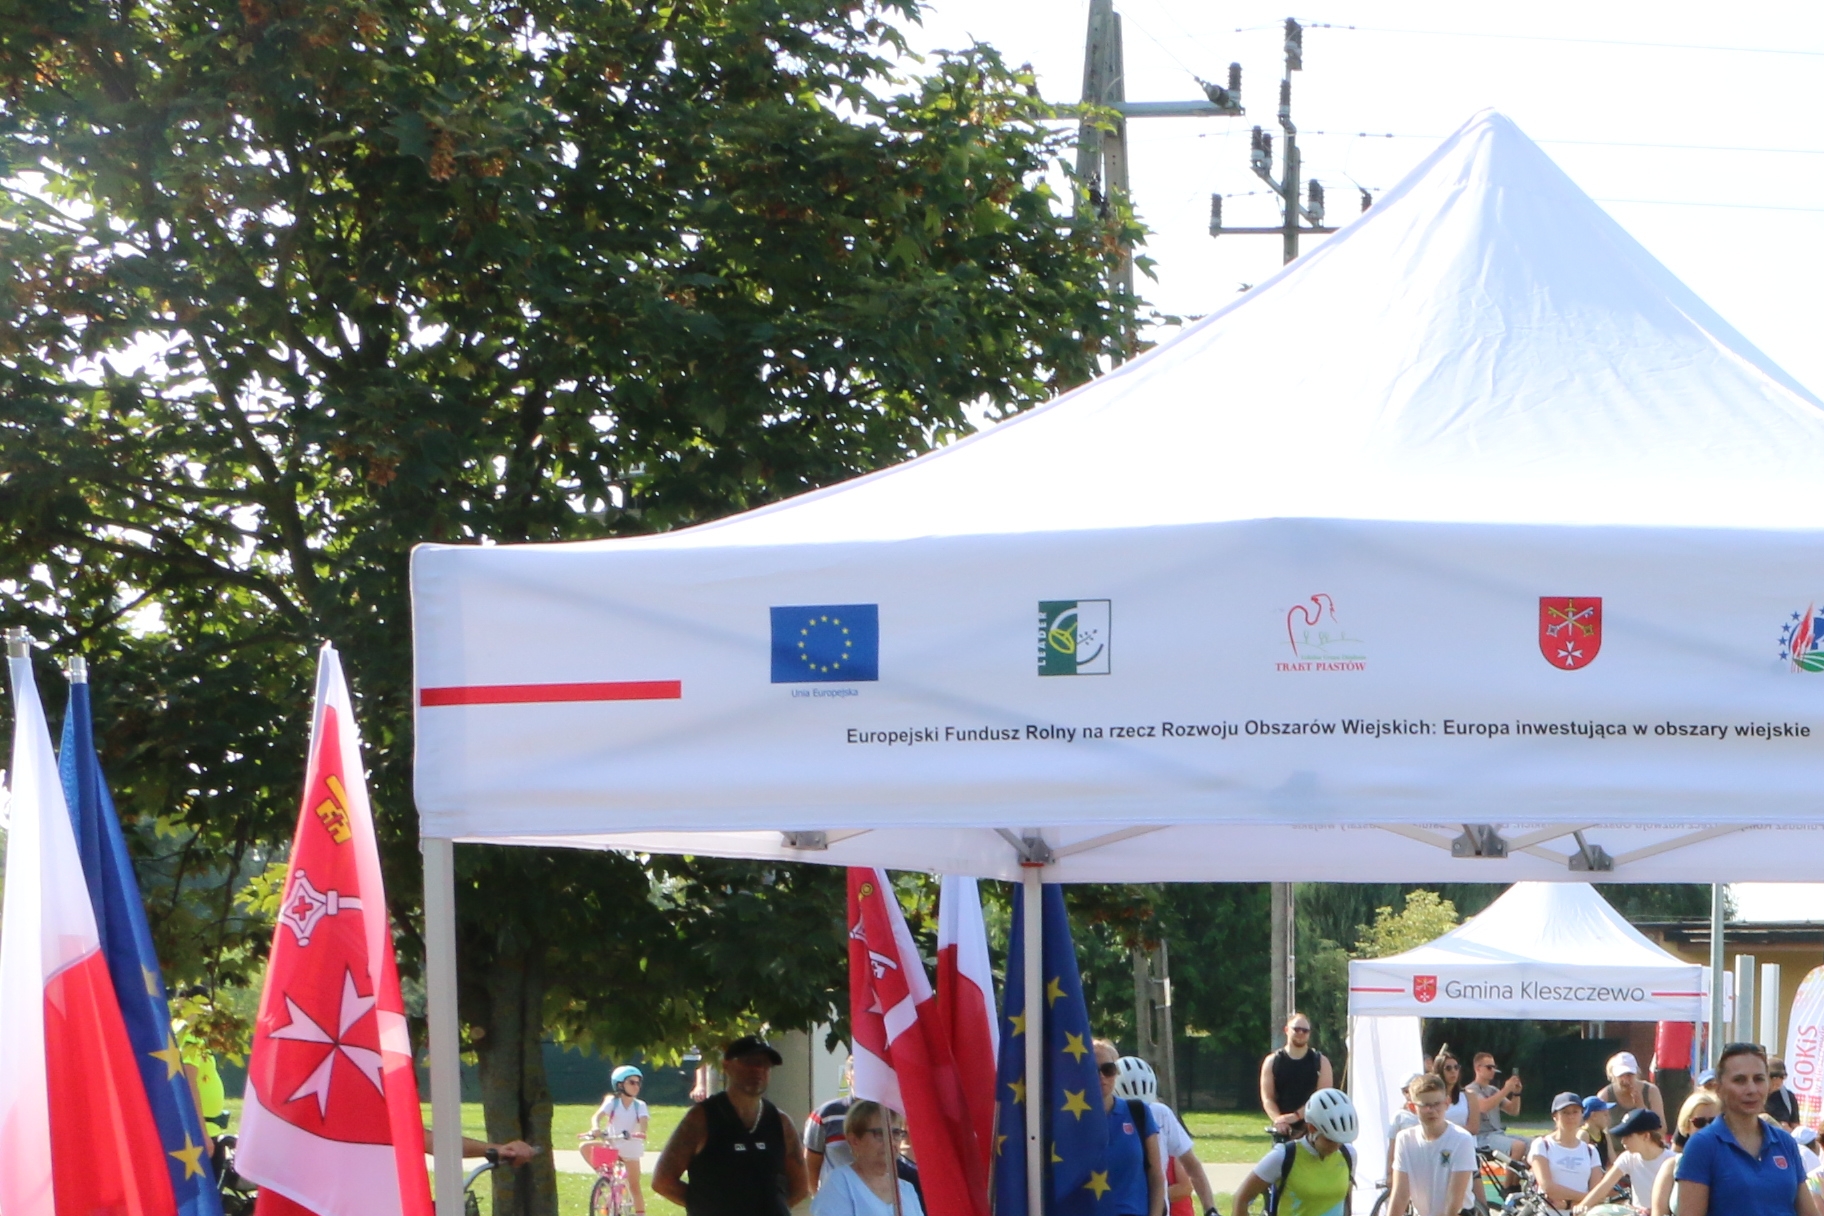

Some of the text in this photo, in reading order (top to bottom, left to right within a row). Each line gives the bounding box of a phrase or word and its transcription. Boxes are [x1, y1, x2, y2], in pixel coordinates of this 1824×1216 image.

[1038, 612, 1048, 666] LEADER
[1275, 660, 1367, 672] TRAKT PIASTÓW
[791, 687, 858, 699] Unia Europejska
[847, 718, 1811, 747] Europejski Fundusz Rolny na rzecz Rozwoju Obszarów Wiejskich: Europa inwestująca w obszary wiejskie
[1445, 979, 1645, 1002] Gmina Kleszczewo
[1792, 1024, 1818, 1092] GOKiS
